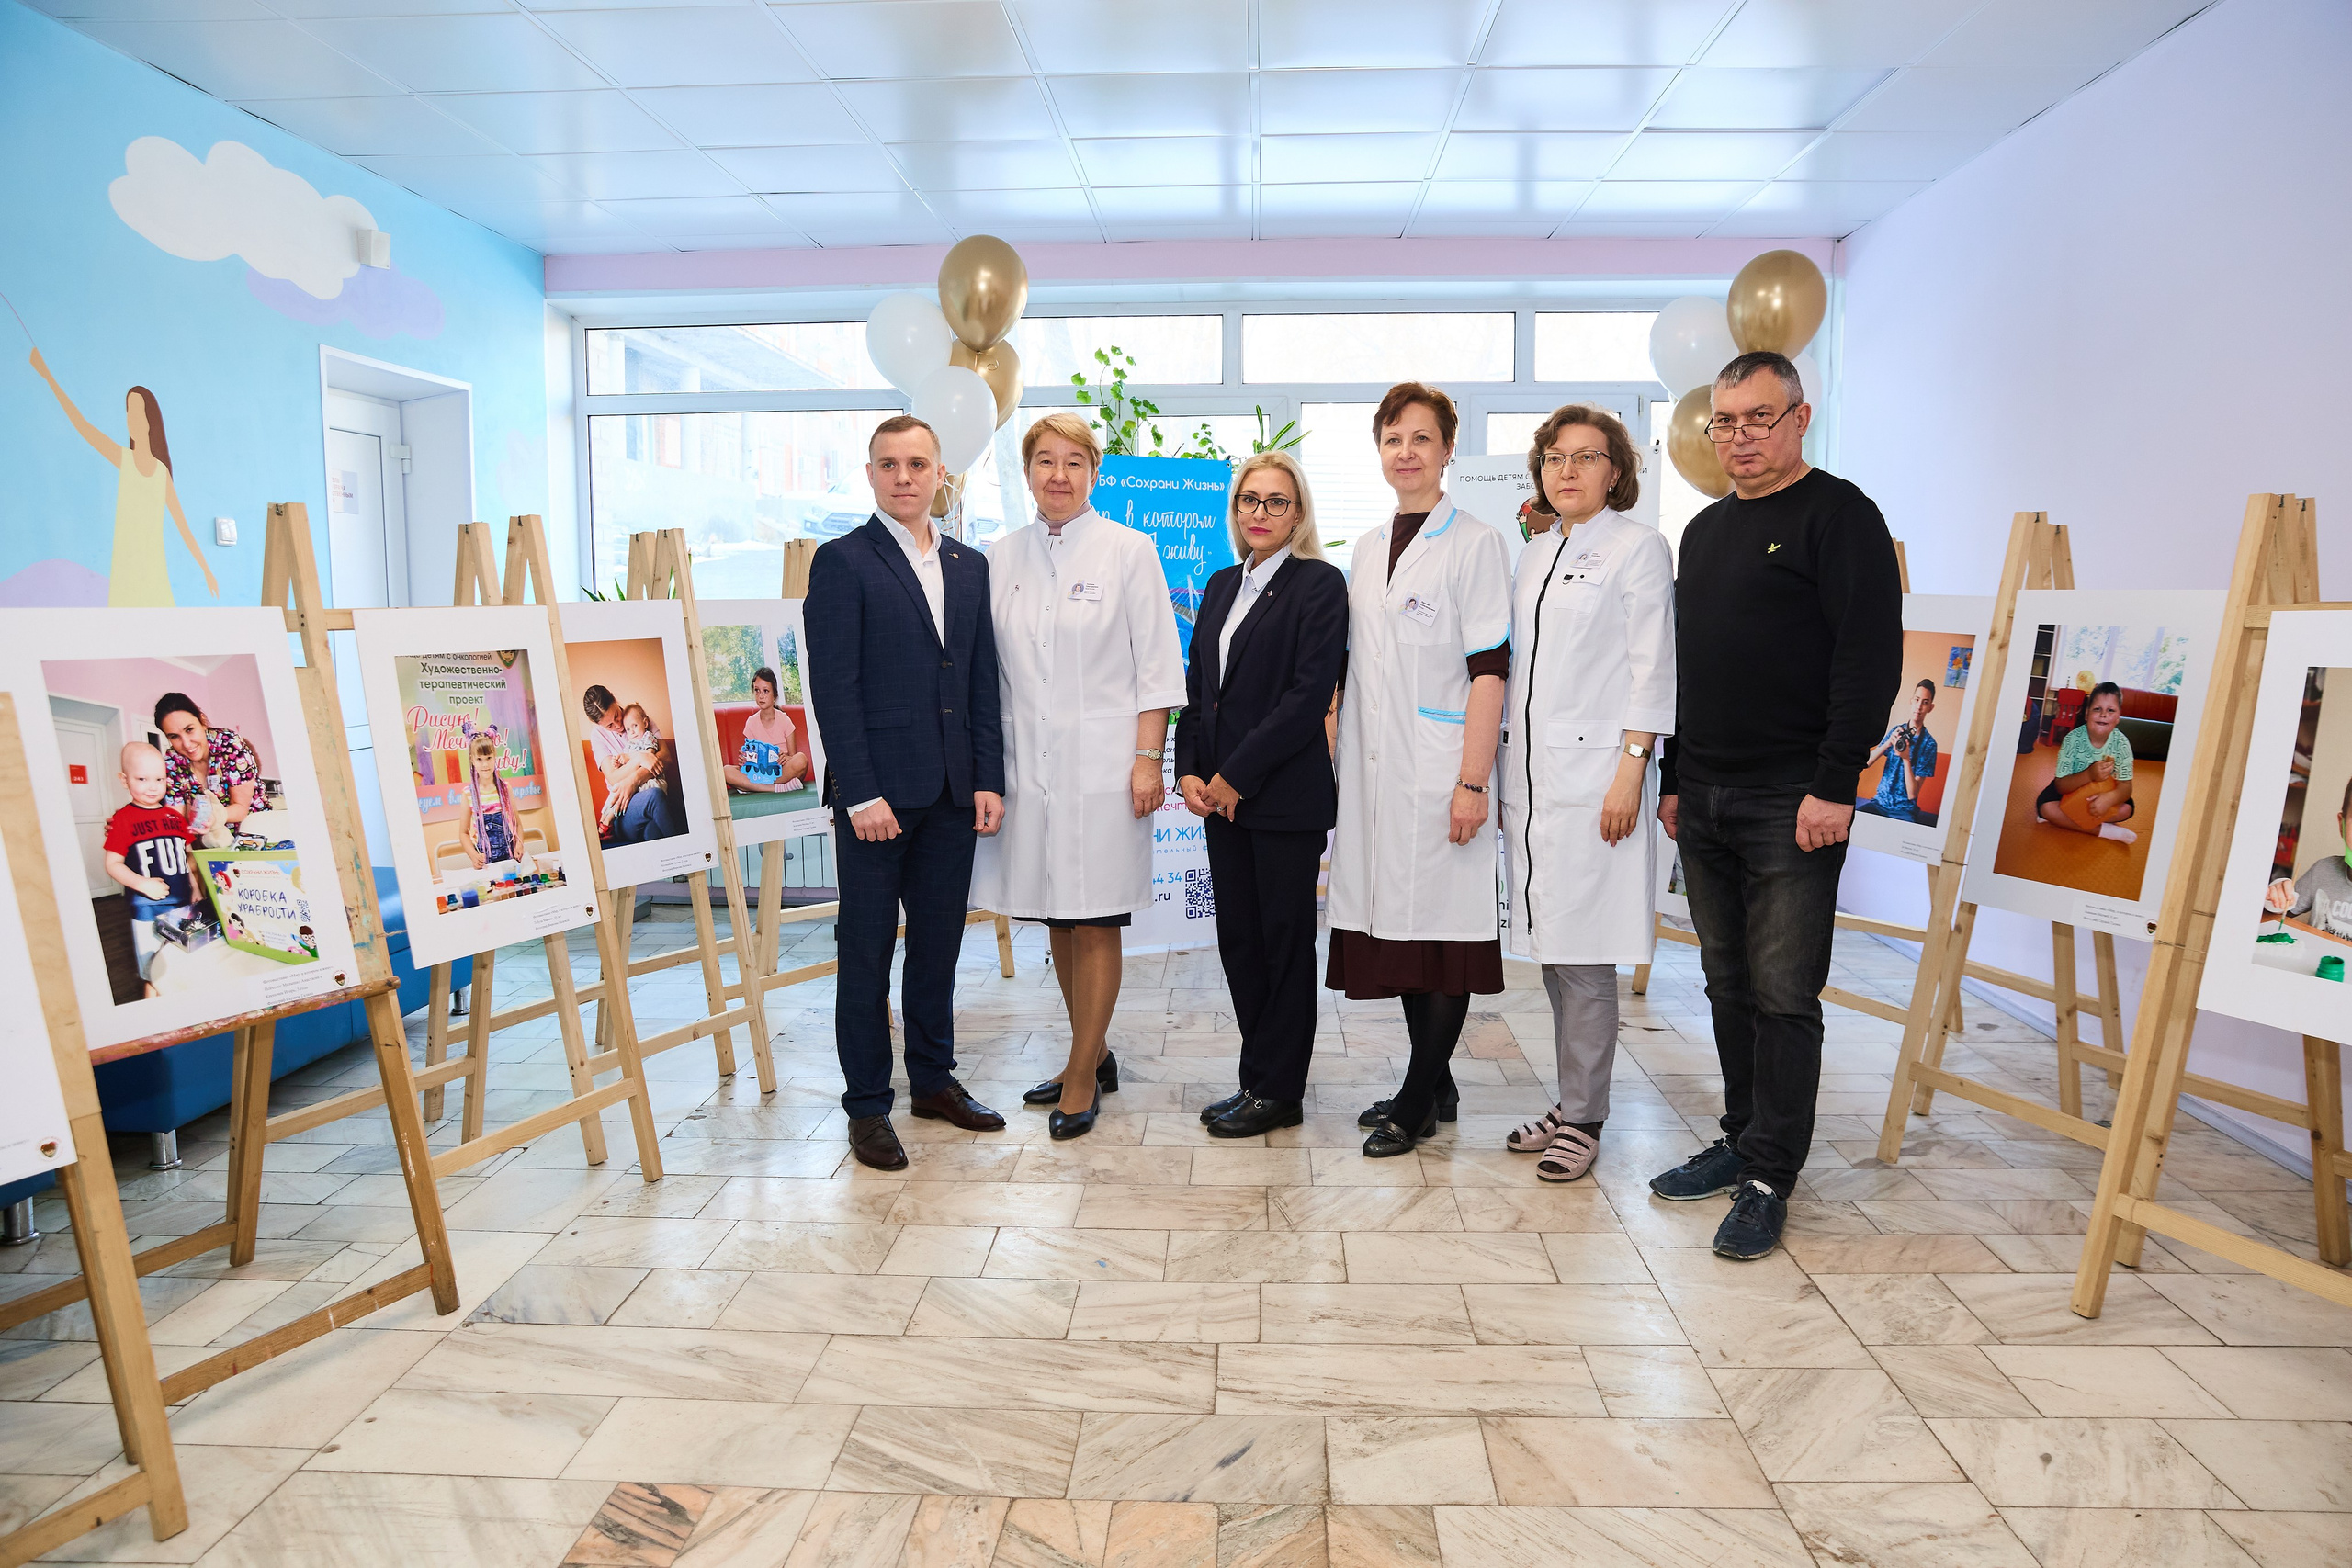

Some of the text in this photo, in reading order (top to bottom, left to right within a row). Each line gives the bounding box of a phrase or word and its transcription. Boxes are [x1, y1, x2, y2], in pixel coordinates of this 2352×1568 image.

[1099, 474, 1225, 491] БФ «Сохрани Жизнь»
[1459, 475, 1496, 483] ПОМОЩЬ
[1498, 473, 1524, 482] ДЕТЯМ
[1125, 499, 1216, 540] в котором
[452, 652, 492, 660] онкологией
[420, 662, 503, 676] Художественно-
[419, 679, 506, 691] терапевтический
[448, 694, 484, 706] проект
[407, 705, 479, 732] Рисую!
[132, 819, 159, 837] JUST
[1156, 845, 1197, 854] тельный
[1167, 872, 1182, 884] 34
[237, 888, 288, 904] КОРОБКА
[1154, 892, 1171, 902] .ru
[237, 903, 297, 920] ХРАБРОСТИ
